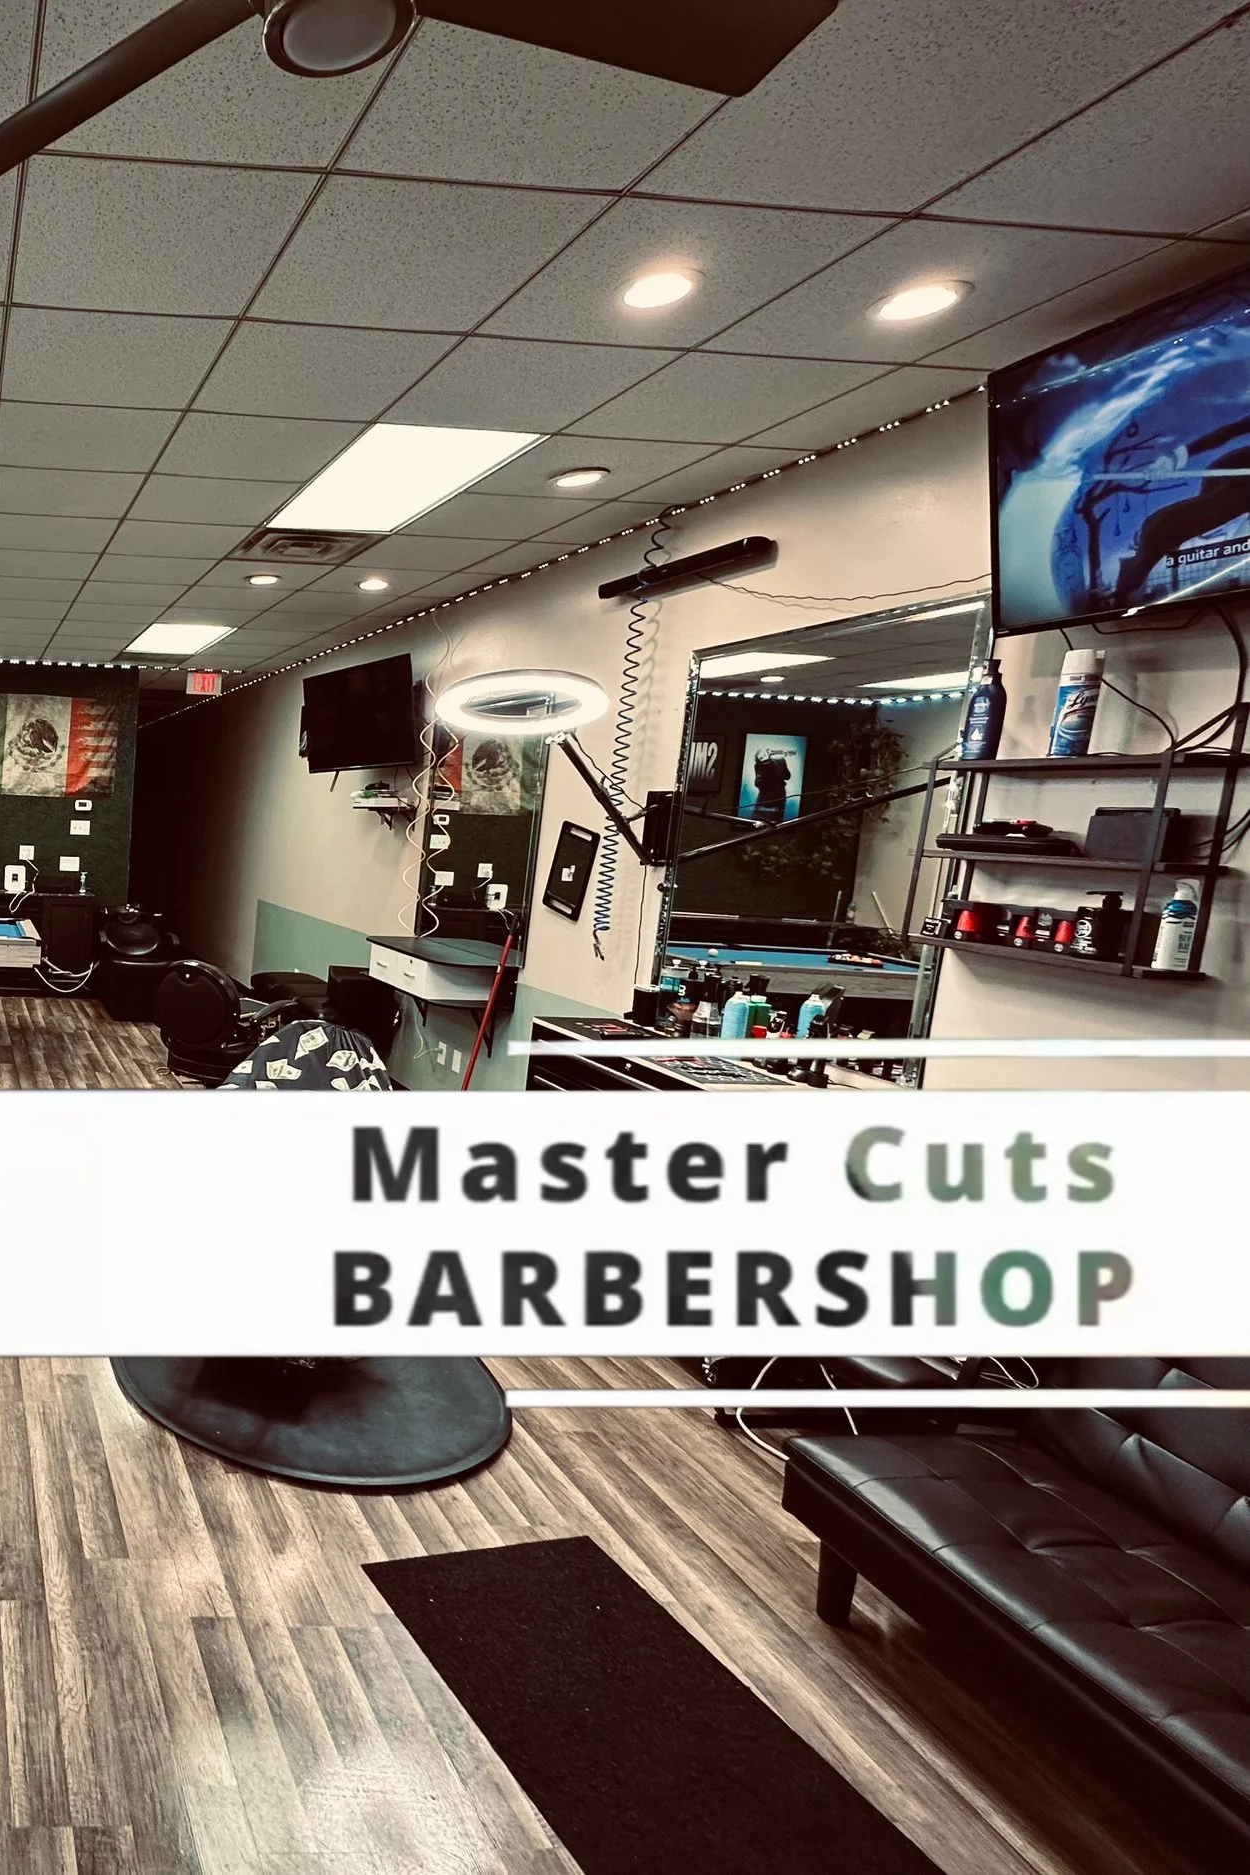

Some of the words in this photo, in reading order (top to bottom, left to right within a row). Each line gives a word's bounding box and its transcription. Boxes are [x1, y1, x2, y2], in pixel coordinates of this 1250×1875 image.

[1166, 557, 1174, 566] a
[1178, 547, 1220, 566] guitar
[1223, 538, 1250, 555] and
[193, 672, 217, 692] EXIT
